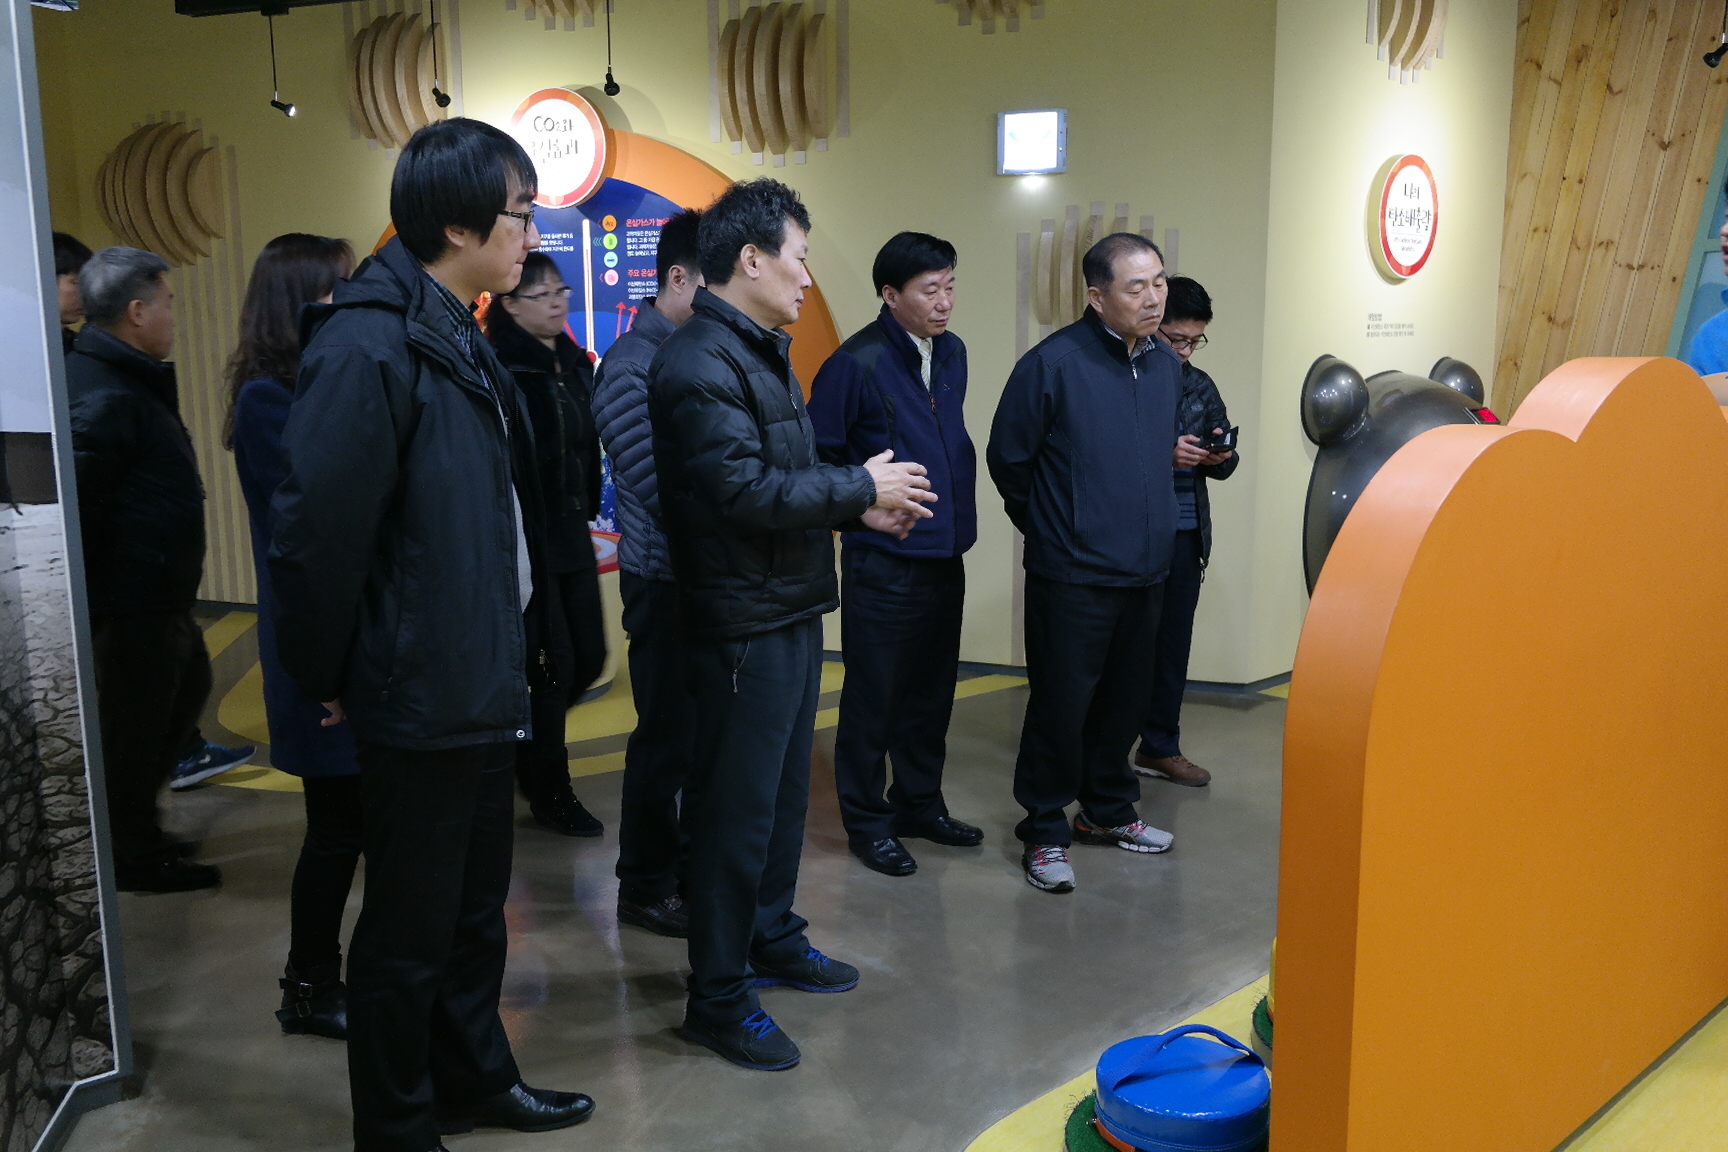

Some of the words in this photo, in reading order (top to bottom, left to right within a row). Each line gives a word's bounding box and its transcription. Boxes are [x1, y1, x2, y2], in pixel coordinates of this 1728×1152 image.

[1404, 183, 1420, 200] 나의
[1388, 207, 1432, 233] 탄소배출량
[627, 269, 640, 277] 주요
